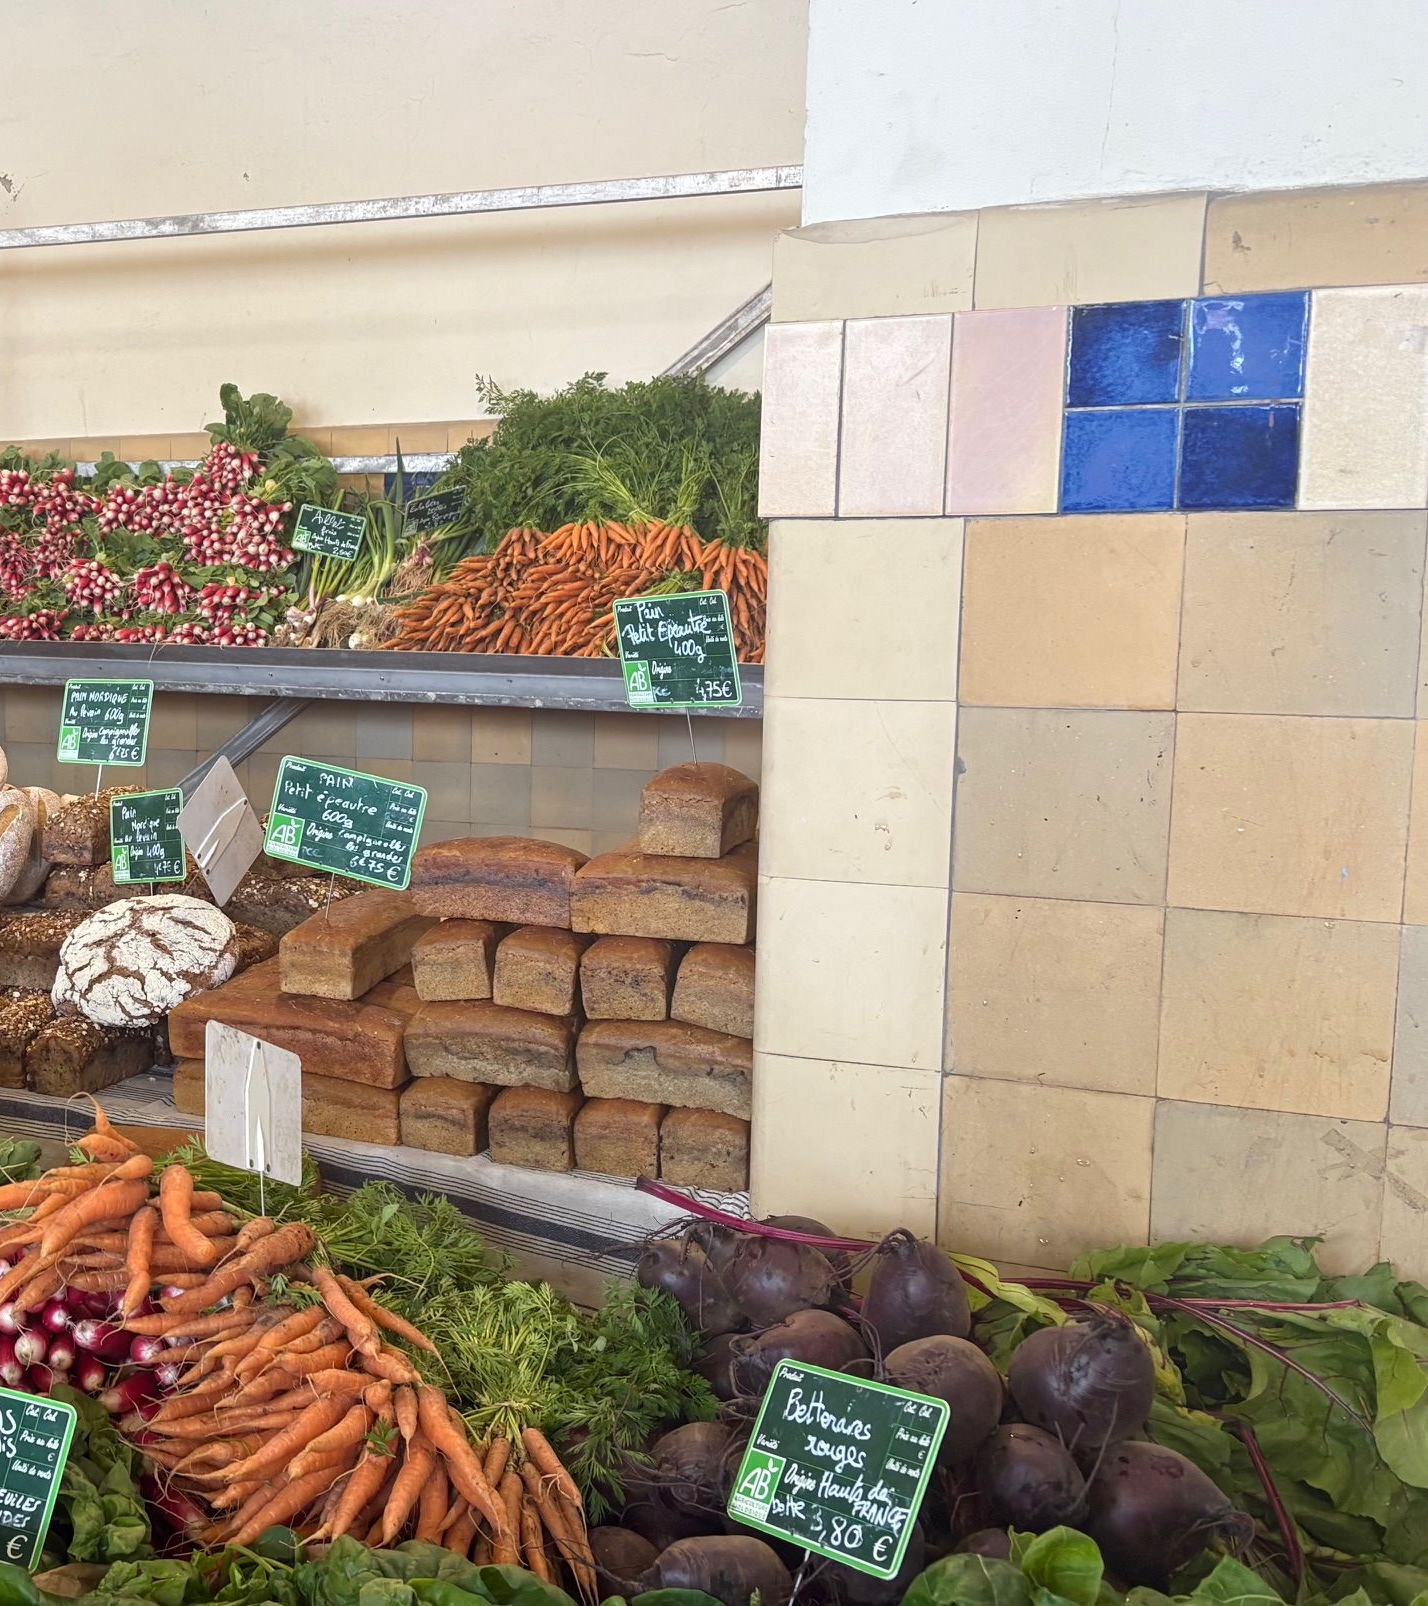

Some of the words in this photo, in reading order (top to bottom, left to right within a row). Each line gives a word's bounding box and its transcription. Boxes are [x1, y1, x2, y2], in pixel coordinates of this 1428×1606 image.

[634, 601, 664, 622] Pain
[621, 623, 655, 645] Petit
[673, 640, 707, 663] 400g
[630, 671, 647, 691] AB
[131, 747, 139, 760] €
[284, 780, 312, 800] Petit
[322, 809, 354, 829] 600g
[271, 824, 296, 845] AB
[307, 823, 334, 842] Origine
[174, 860, 181, 874] €
[387, 866, 401, 881] €
[779, 1367, 805, 1382] Produit
[804, 1434, 867, 1473] rouges
[739, 1467, 772, 1500] AB
[784, 1463, 816, 1495] Origine
[818, 1471, 864, 1504] Hauts
[810, 1504, 864, 1549] 3,80
[873, 1535, 893, 1562] €
[6, 1534, 28, 1559] €
